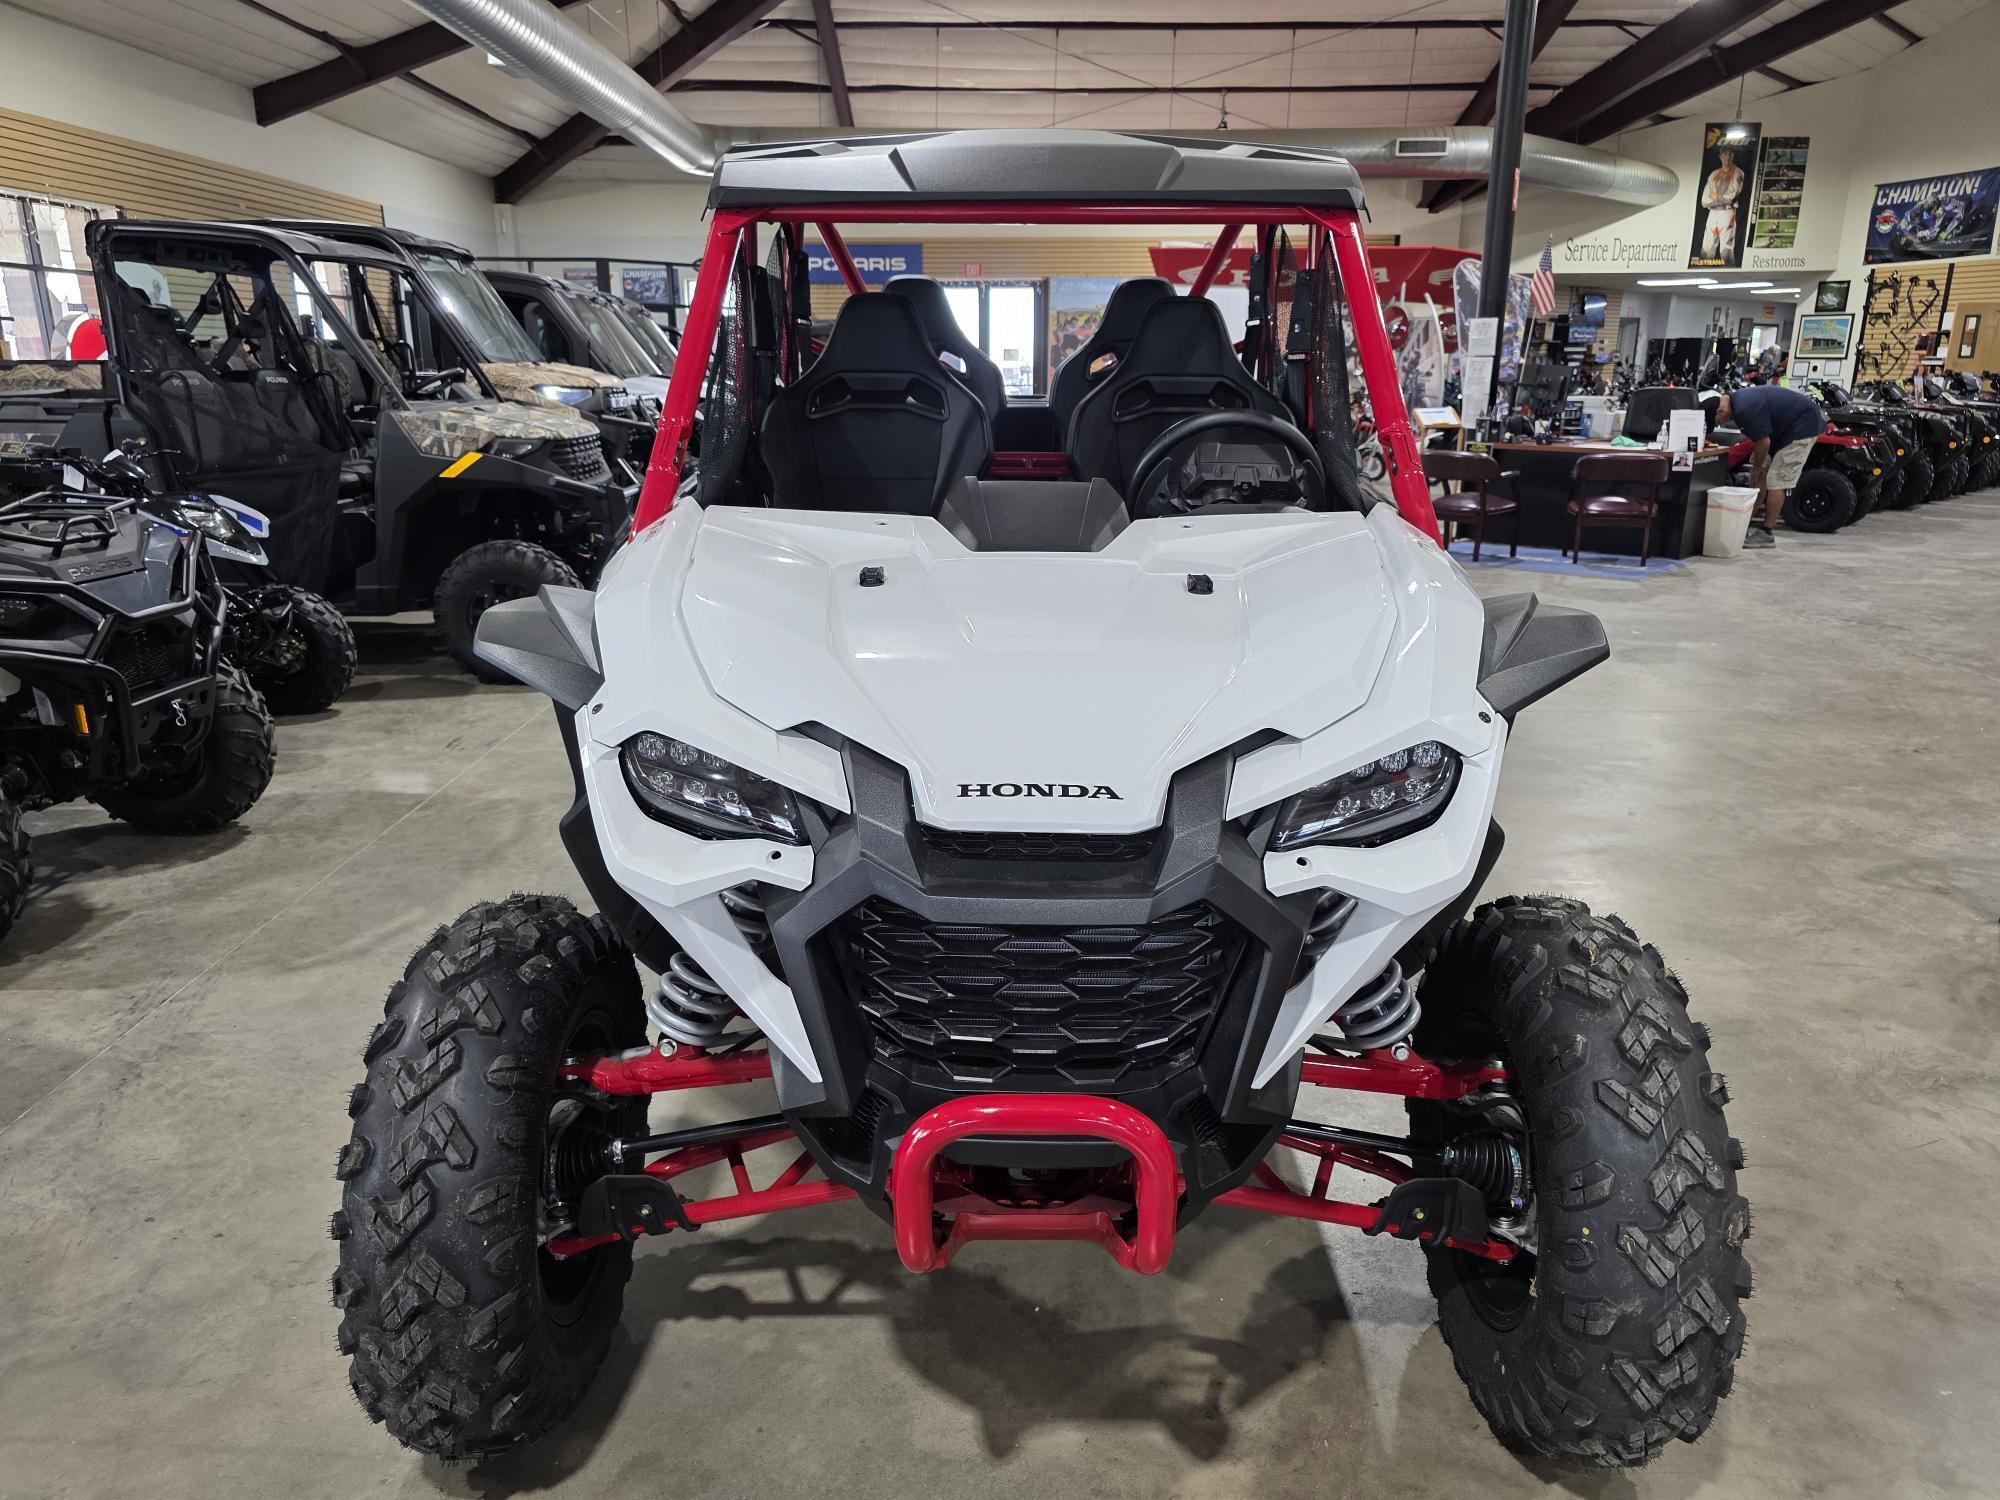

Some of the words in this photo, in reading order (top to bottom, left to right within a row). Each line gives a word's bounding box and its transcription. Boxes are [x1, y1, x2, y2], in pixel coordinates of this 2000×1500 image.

[1876, 176, 1982, 207] CHAMPION!
[1564, 237, 1609, 263] Service
[1611, 237, 1678, 268] Department
[1752, 255, 1806, 269] Restrooms
[808, 256, 907, 272] POARIS
[67, 556, 133, 580] POLARIS
[956, 783, 1124, 801] HONDA
